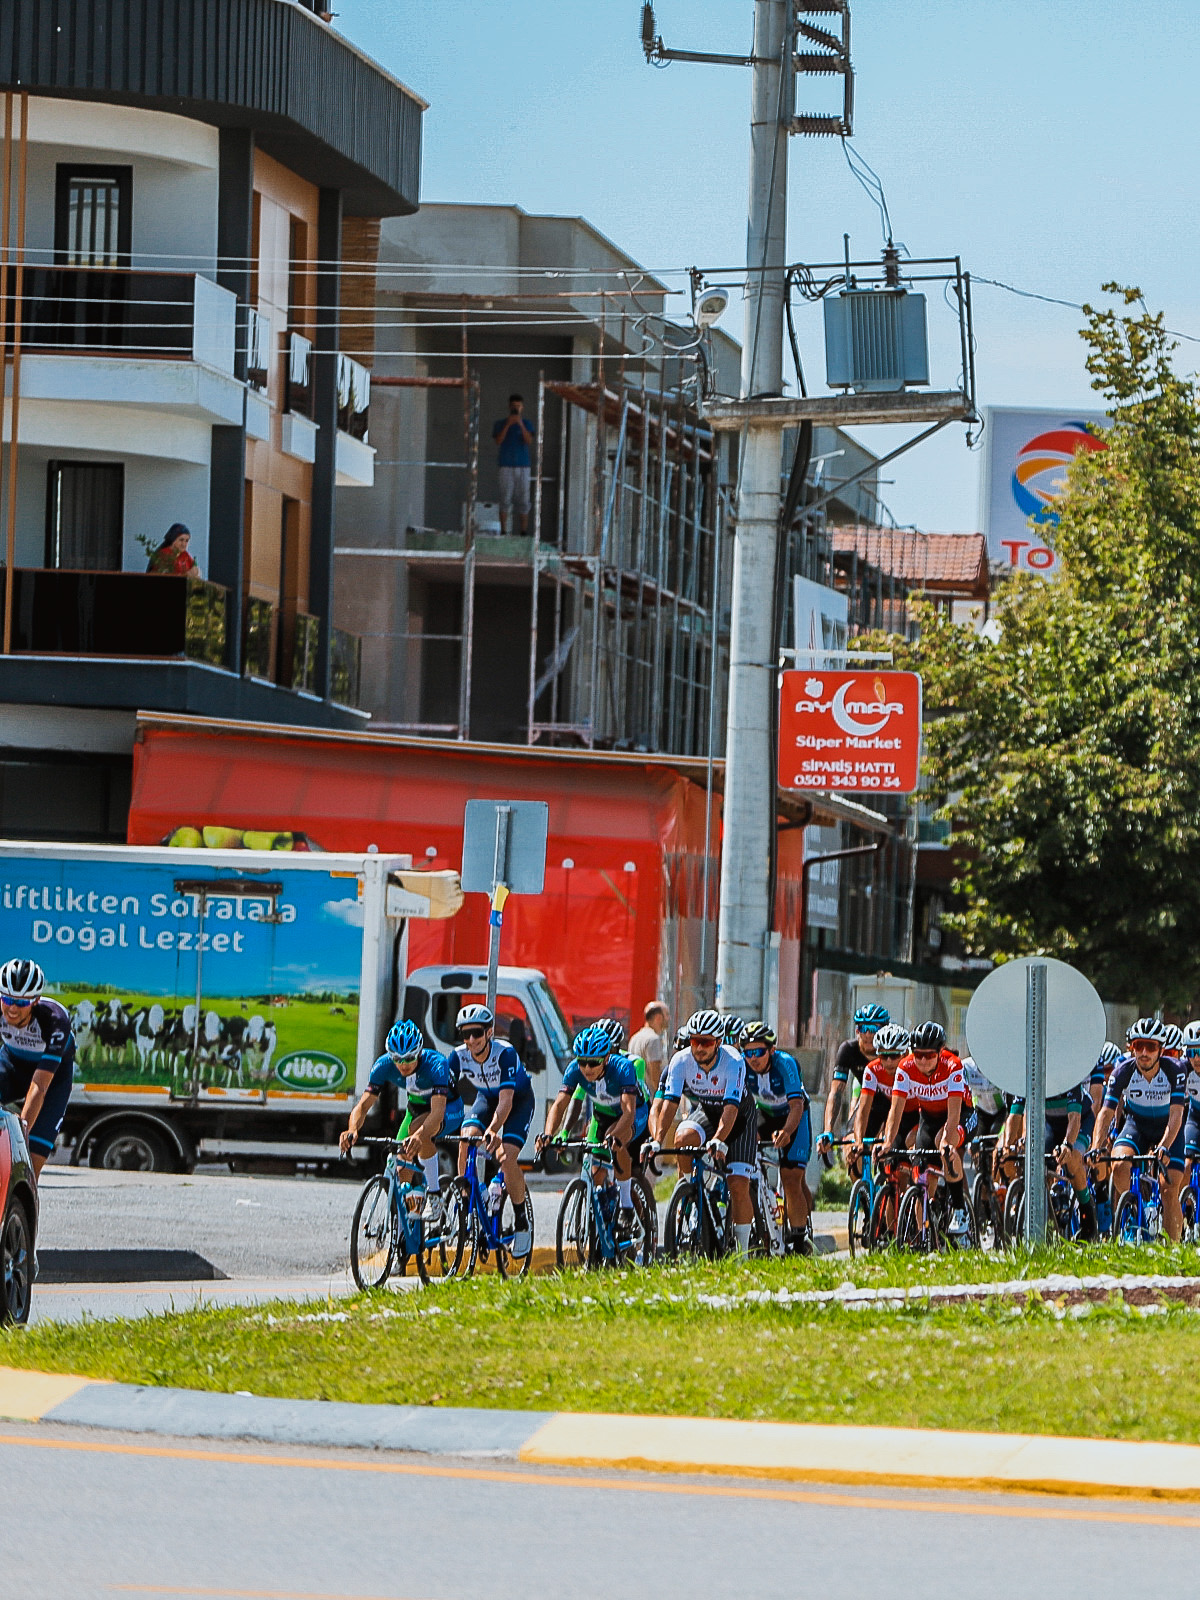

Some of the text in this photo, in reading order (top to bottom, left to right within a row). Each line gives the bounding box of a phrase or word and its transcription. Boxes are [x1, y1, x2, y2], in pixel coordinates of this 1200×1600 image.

[795, 735, 902, 750] Süper Market
[801, 758, 896, 775] SİPARİŞ HATTI
[794, 774, 901, 787] 0501 343 90 54
[0, 884, 139, 915] iftlikten
[33, 919, 245, 953] Doğal Lezzet
